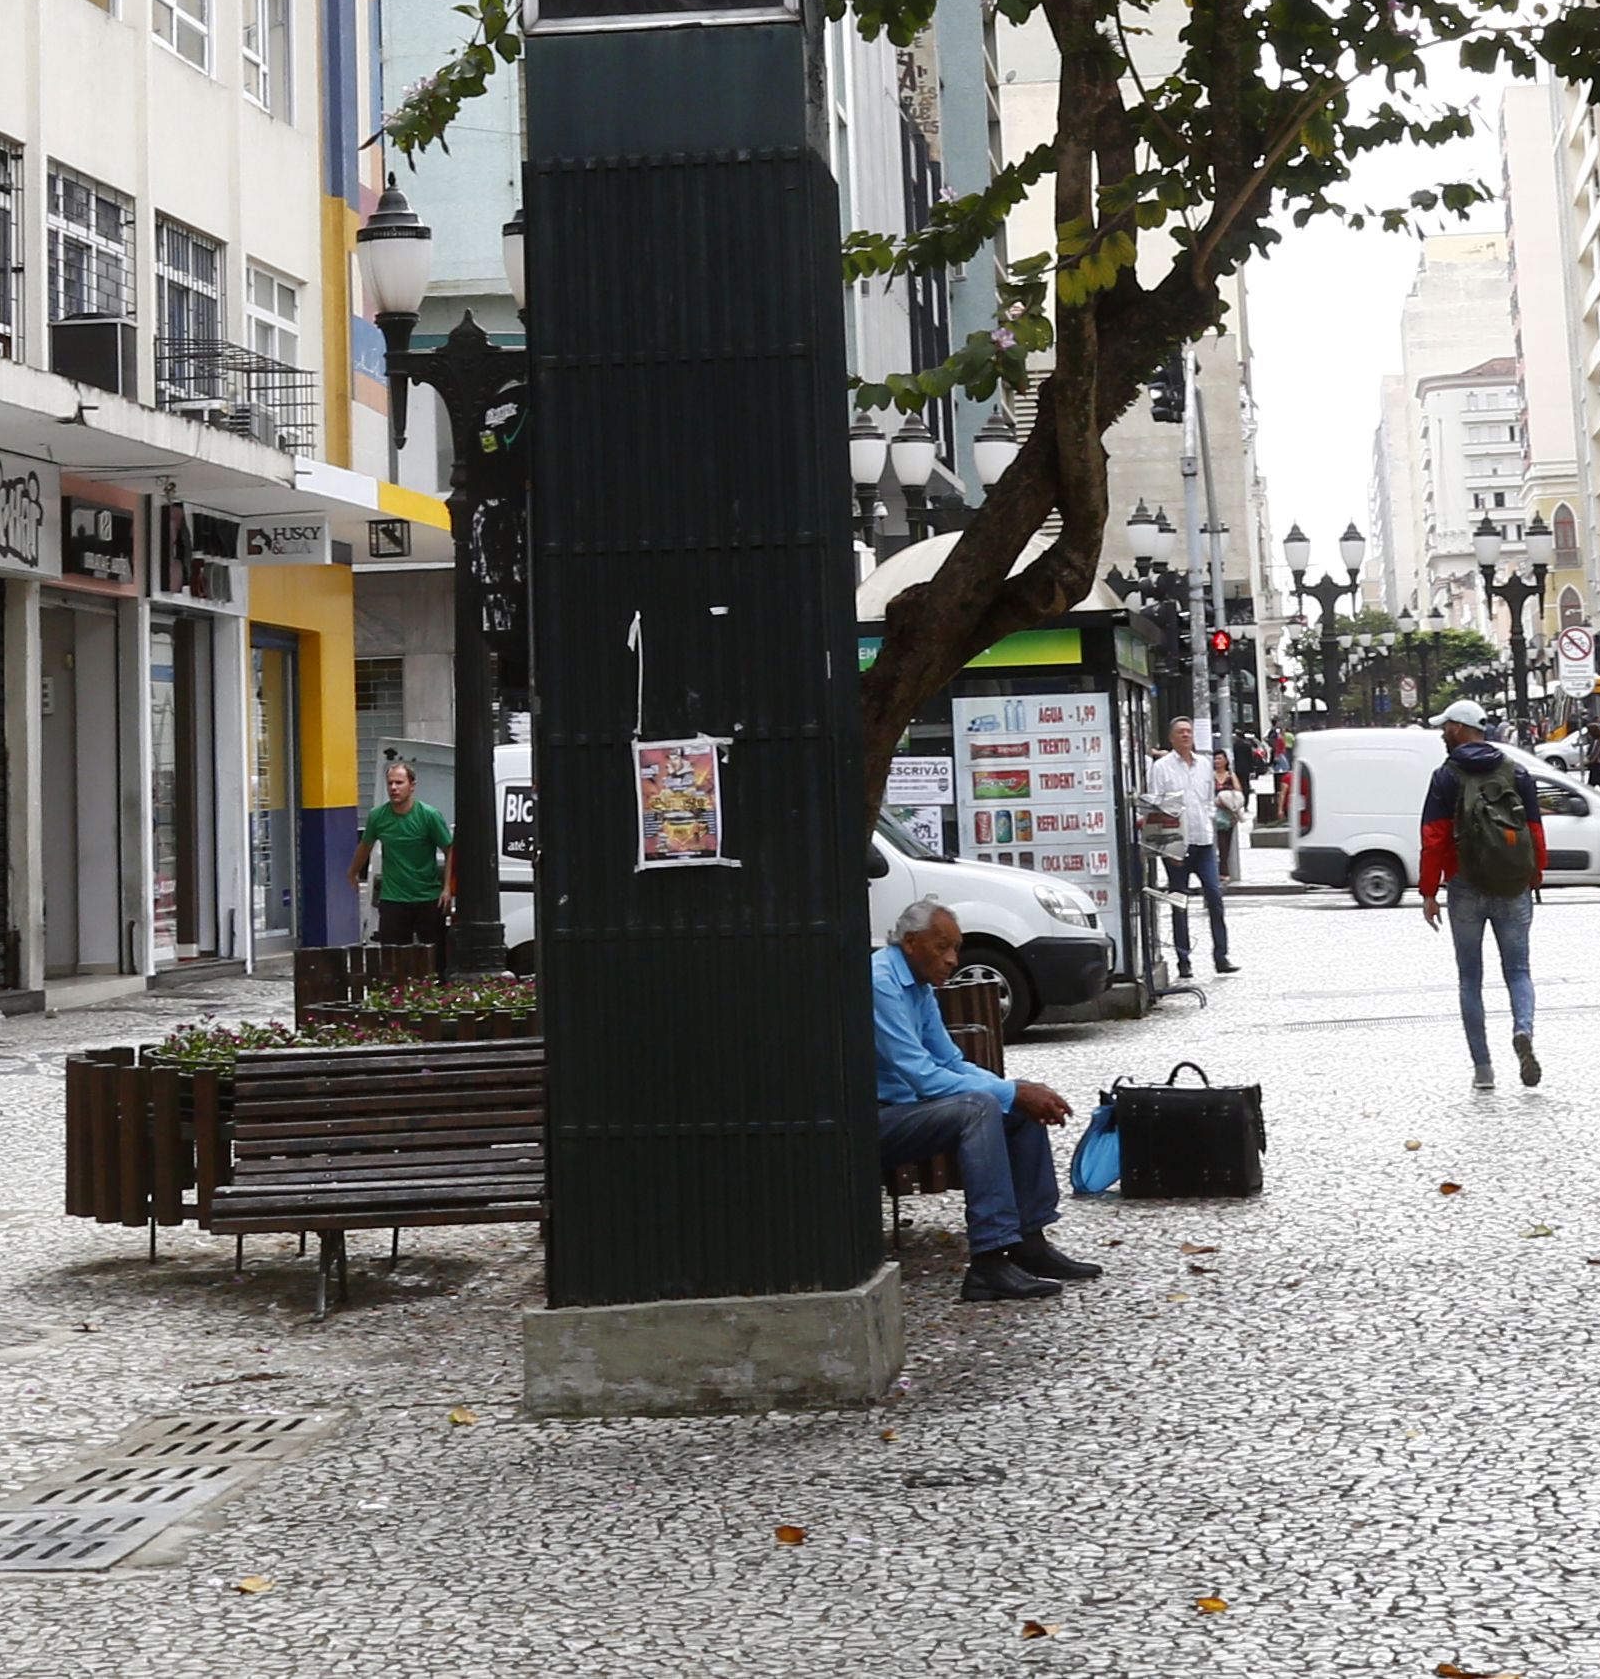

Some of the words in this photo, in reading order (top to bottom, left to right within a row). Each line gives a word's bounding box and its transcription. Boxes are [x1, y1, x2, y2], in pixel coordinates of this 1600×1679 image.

[272, 526, 321, 540] HUSKY
[1076, 705, 1096, 725] 1,99
[1038, 737, 1071, 755] TRENTO
[889, 764, 949, 775] ESCRIVÃO
[1039, 772, 1075, 789] TRIDENT
[1037, 814, 1058, 831] REFRI
[1087, 812, 1103, 832] 3,49
[507, 839, 526, 851] até
[1042, 855, 1061, 872] COCA
[1091, 852, 1107, 873] 1,99
